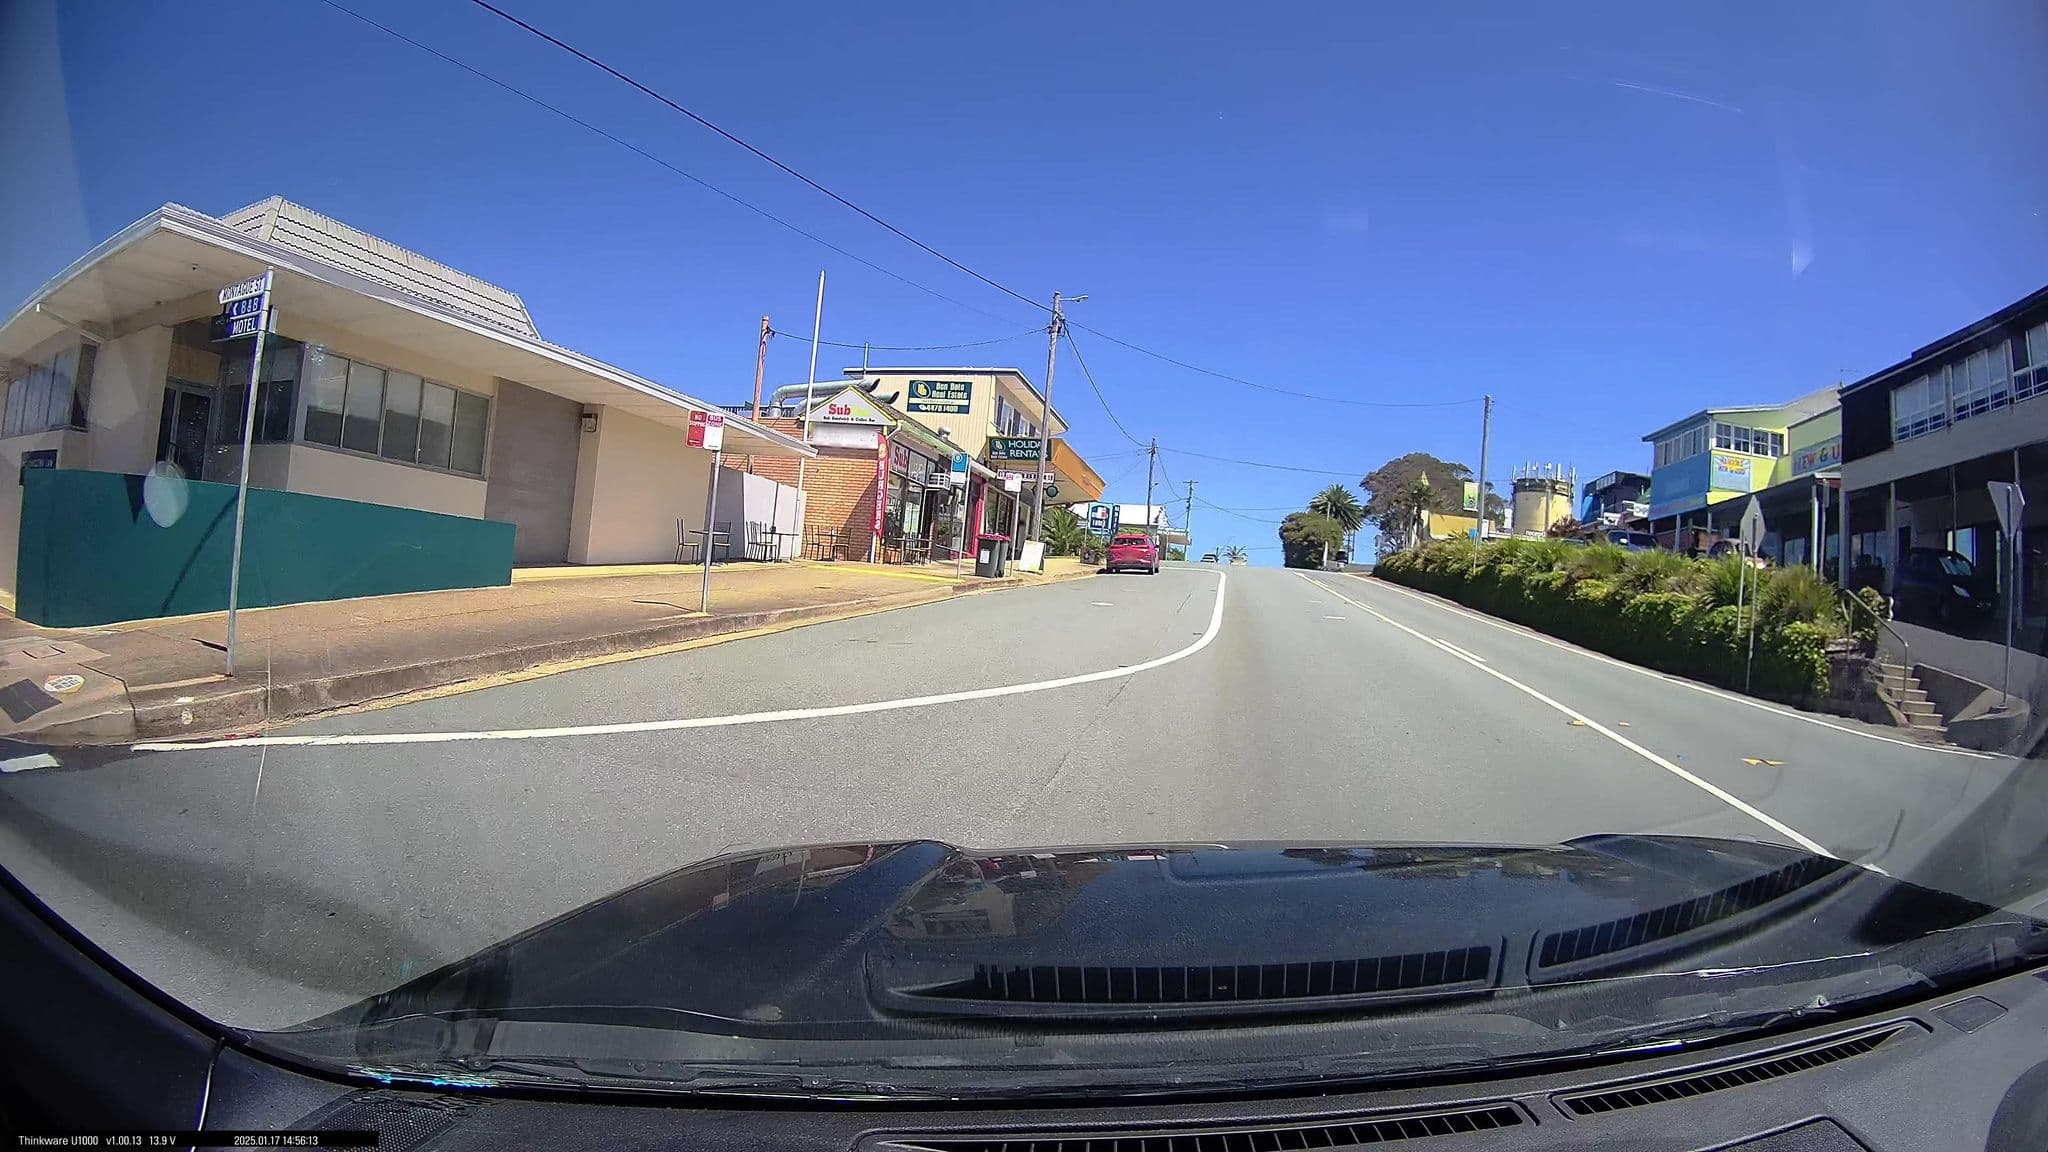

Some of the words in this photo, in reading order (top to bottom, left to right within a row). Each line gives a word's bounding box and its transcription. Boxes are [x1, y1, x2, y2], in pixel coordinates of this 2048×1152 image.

[232, 317, 256, 335] MOTEL
[931, 390, 946, 398] Real
[947, 391, 968, 399] Estate
[828, 403, 851, 416] Sub
[1008, 440, 1041, 449] HOLIDA
